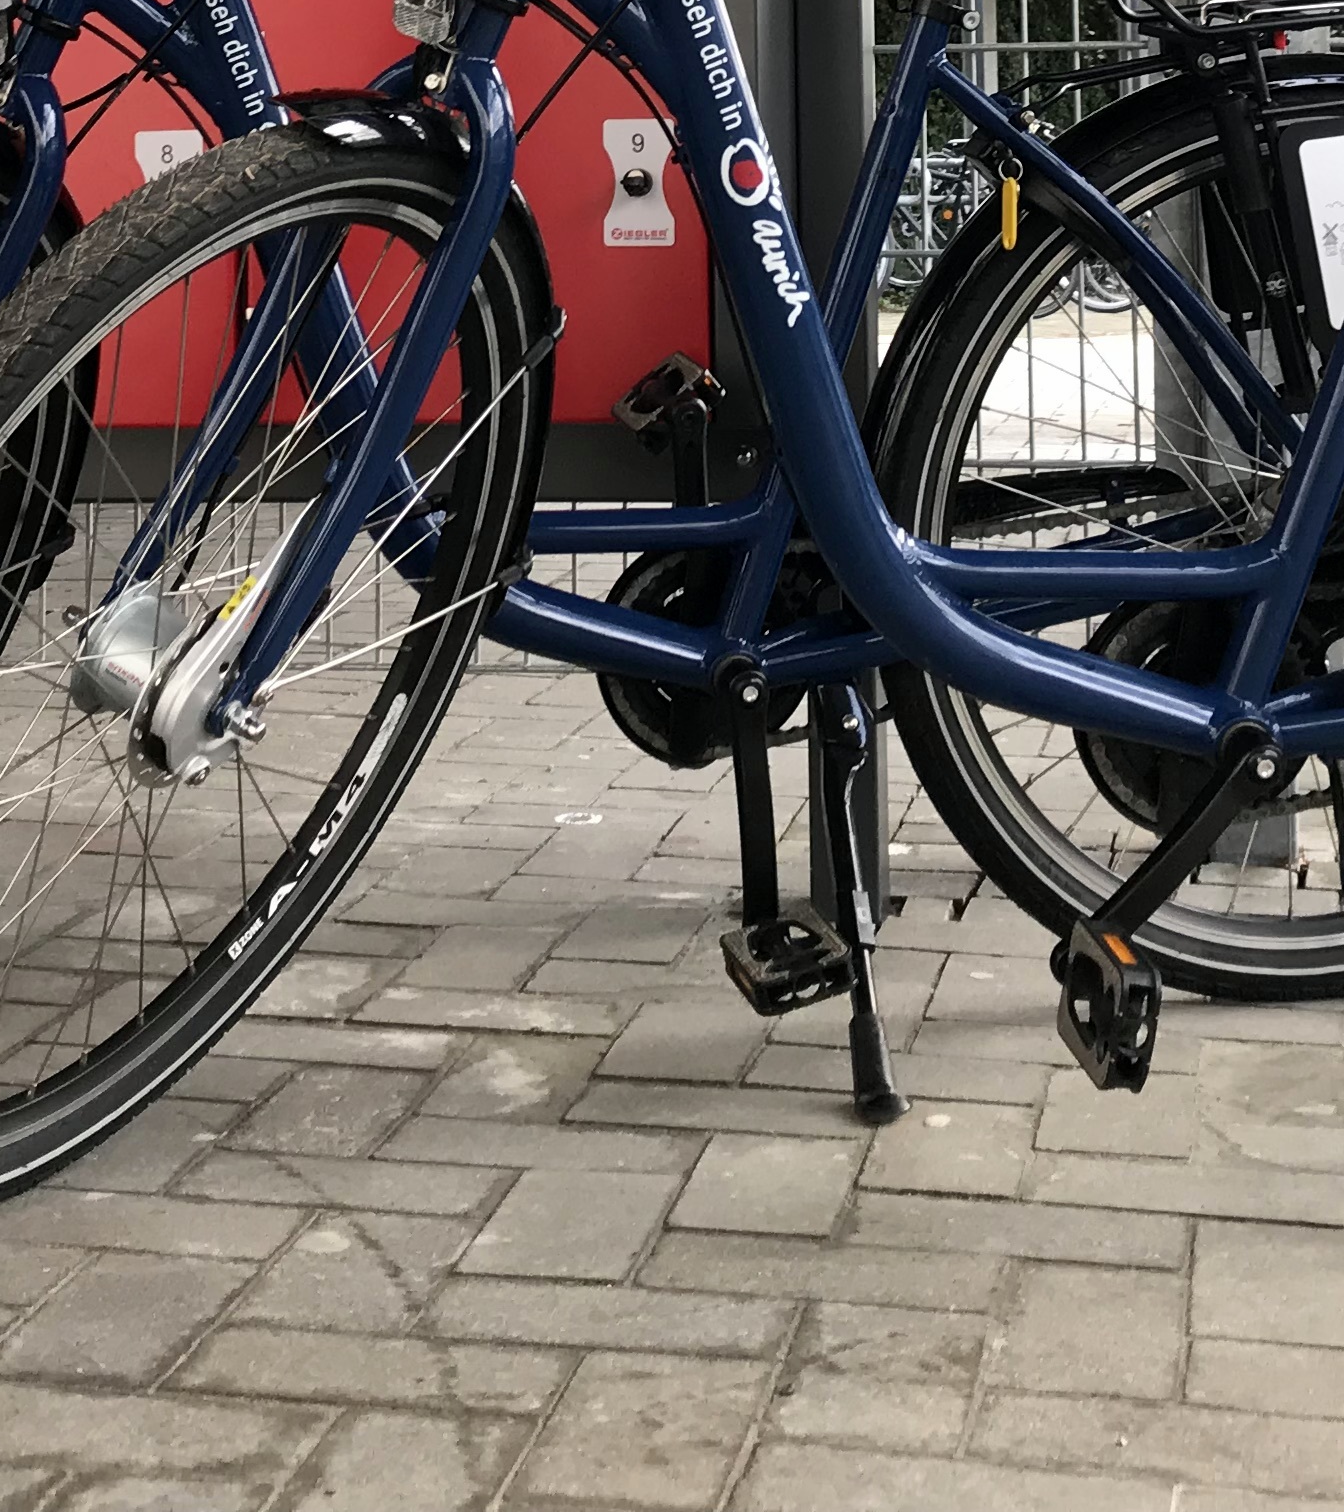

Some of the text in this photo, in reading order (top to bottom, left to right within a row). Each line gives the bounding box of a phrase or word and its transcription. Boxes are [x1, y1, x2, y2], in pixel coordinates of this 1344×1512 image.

[222, 39, 259, 89] dich
[242, 89, 266, 117] in
[700, 43, 737, 100] dich
[719, 100, 743, 132] in
[161, 144, 174, 164] 8
[631, 133, 645, 153] 9
[611, 227, 669, 240] ZIEGLER
[752, 219, 811, 328] aurich
